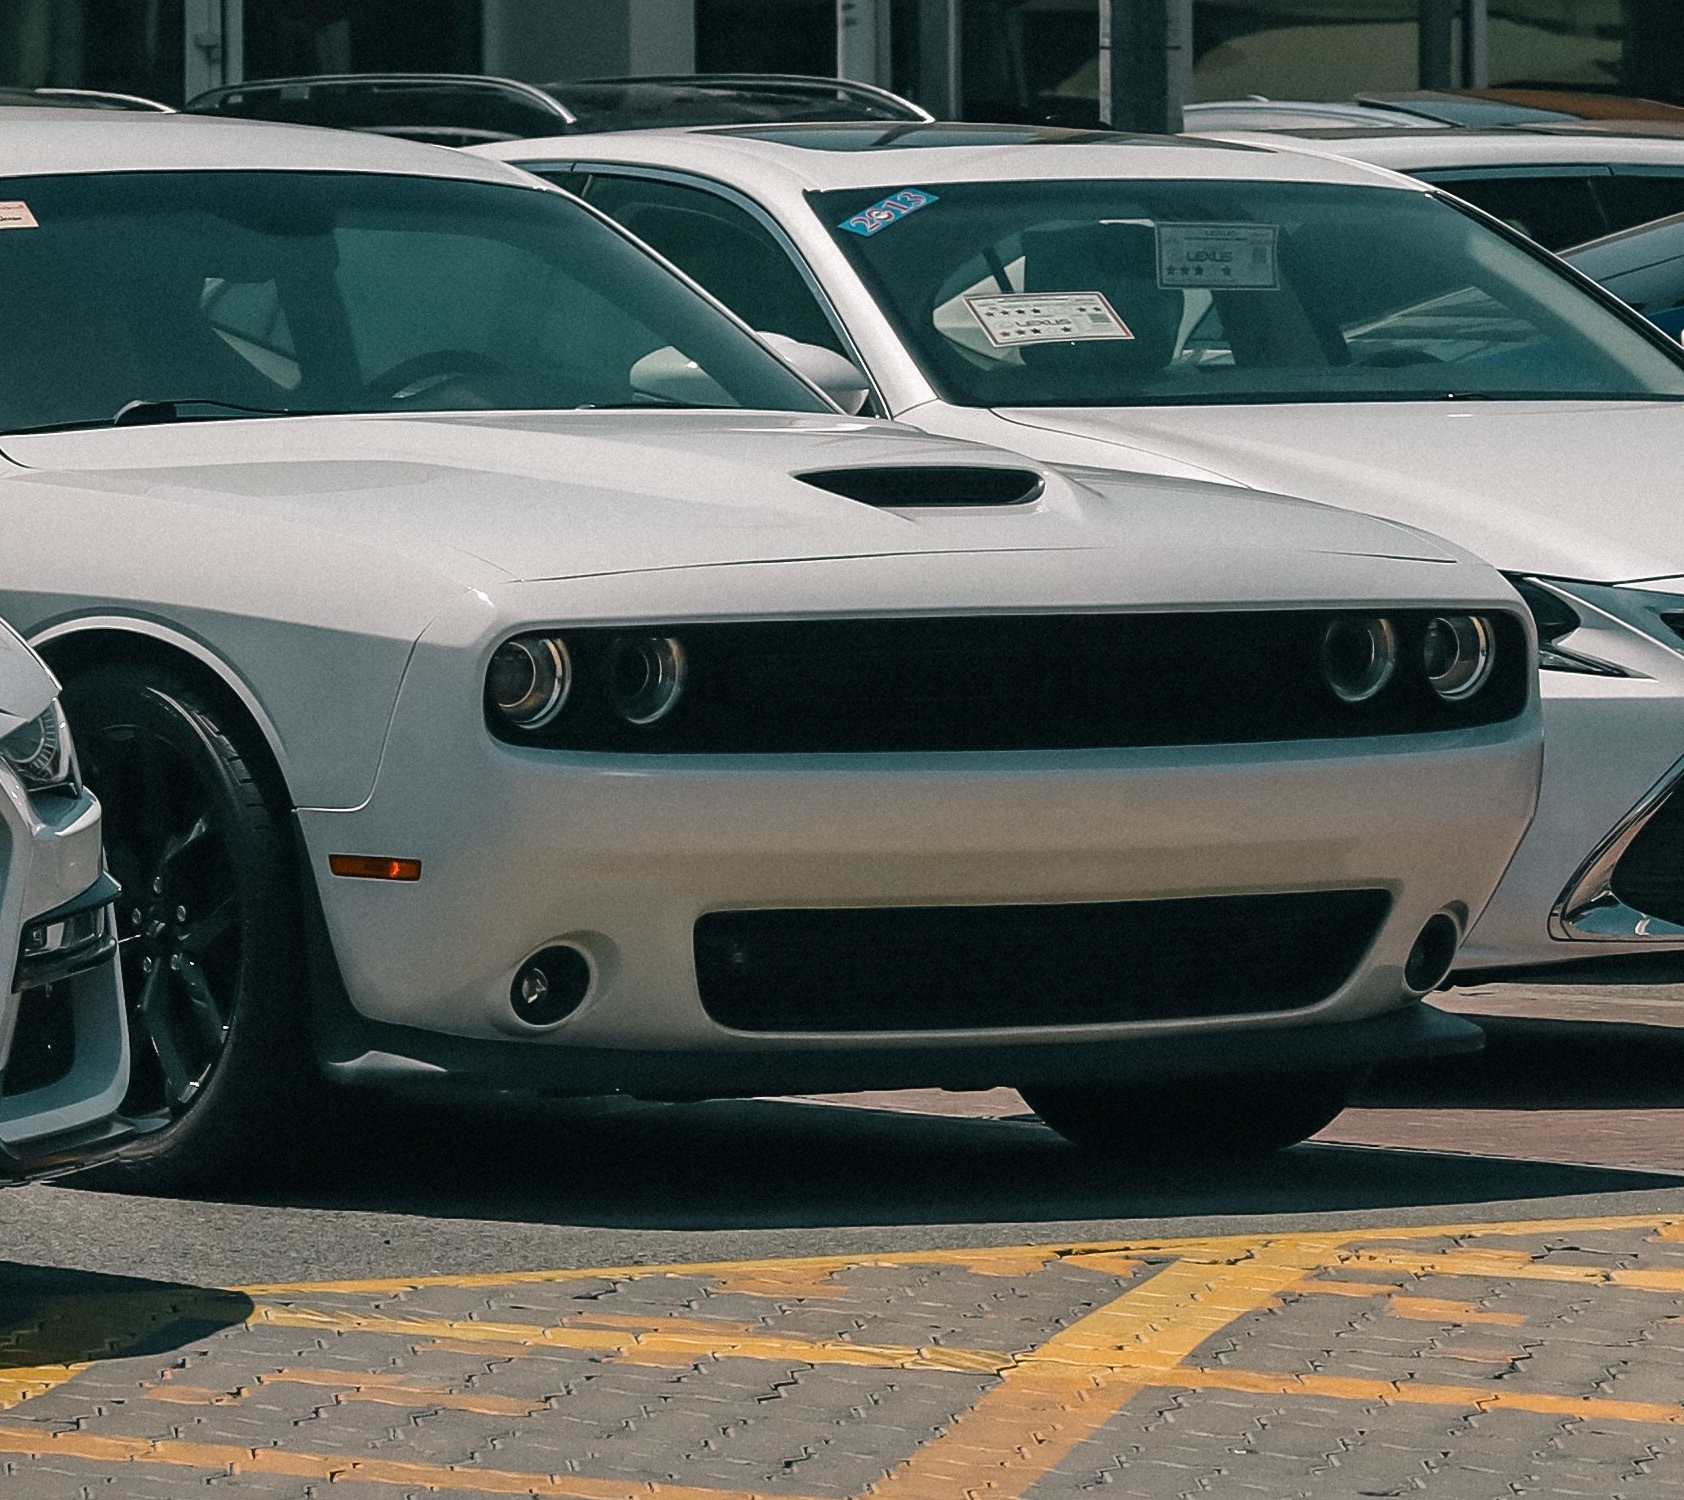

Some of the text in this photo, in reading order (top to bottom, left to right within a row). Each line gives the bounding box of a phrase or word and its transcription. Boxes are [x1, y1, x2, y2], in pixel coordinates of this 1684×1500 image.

[850, 191, 927, 232] 2013
[1186, 250, 1234, 262] LEXUS
[1015, 318, 1072, 327] LEXUS
